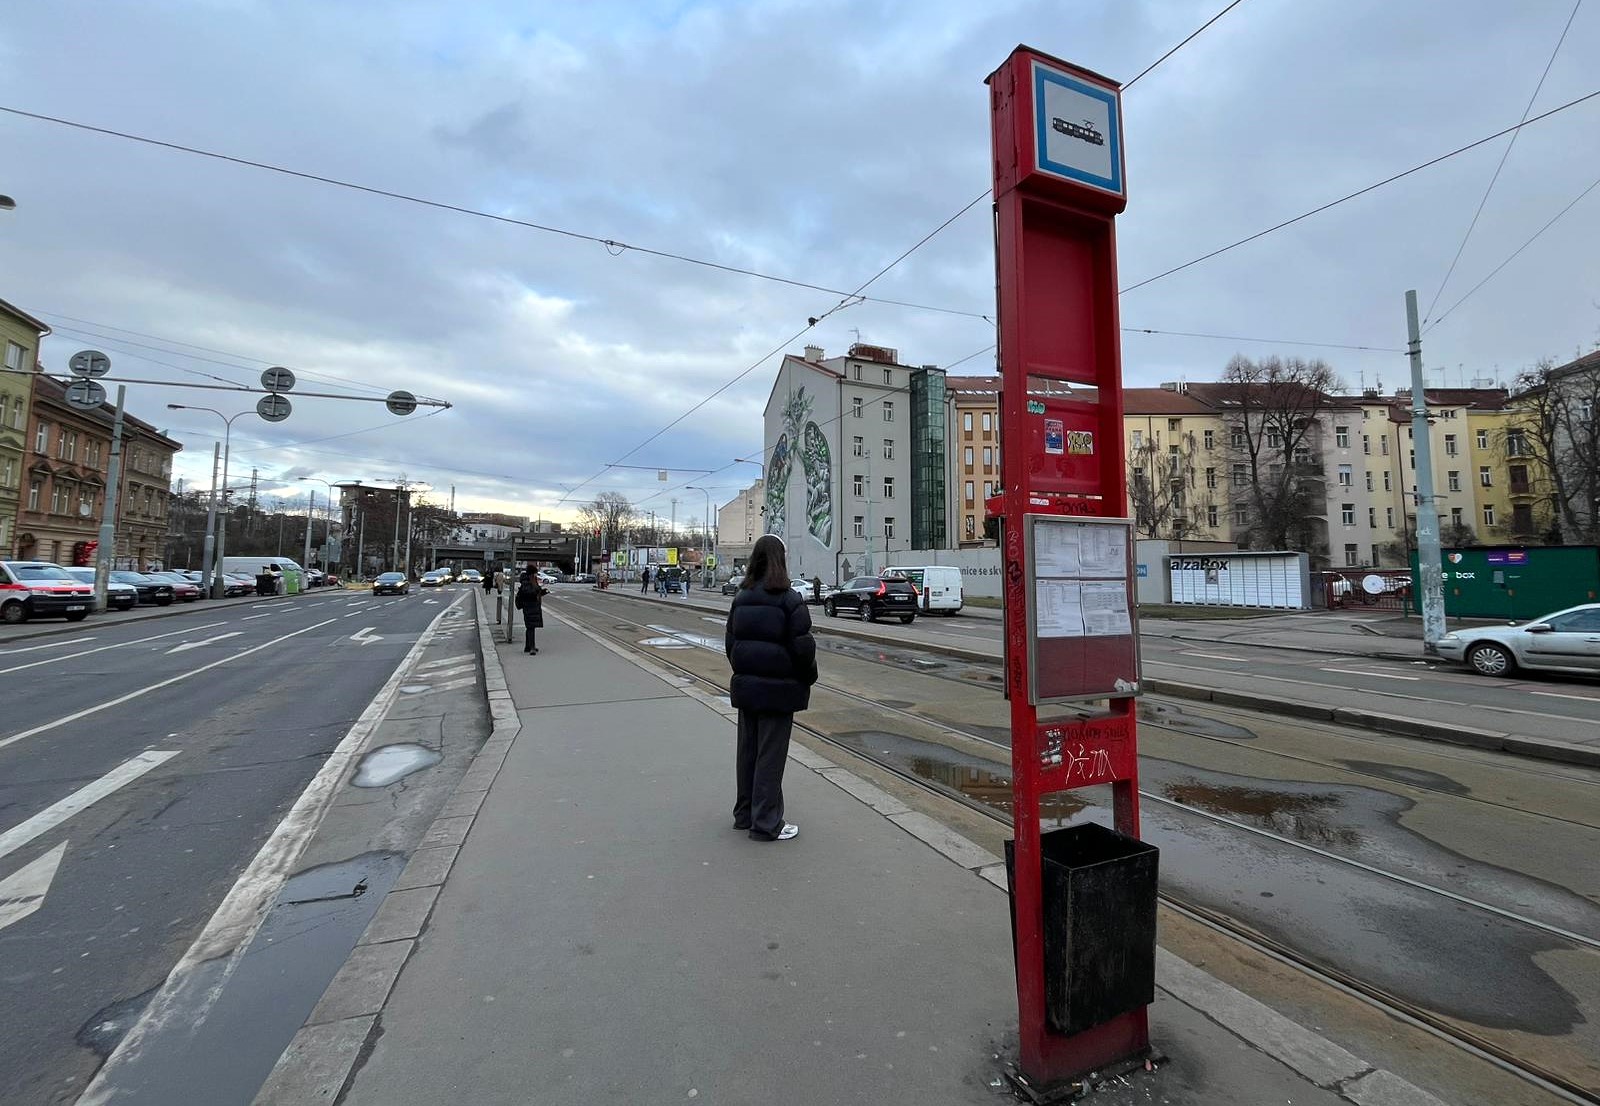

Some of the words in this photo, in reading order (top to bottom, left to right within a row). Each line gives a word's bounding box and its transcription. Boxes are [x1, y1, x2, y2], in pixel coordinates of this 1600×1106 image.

[1171, 557, 1228, 571] alzaBox
[960, 565, 977, 576] nice
[978, 567, 988, 576] se
[1455, 571, 1475, 579] box
